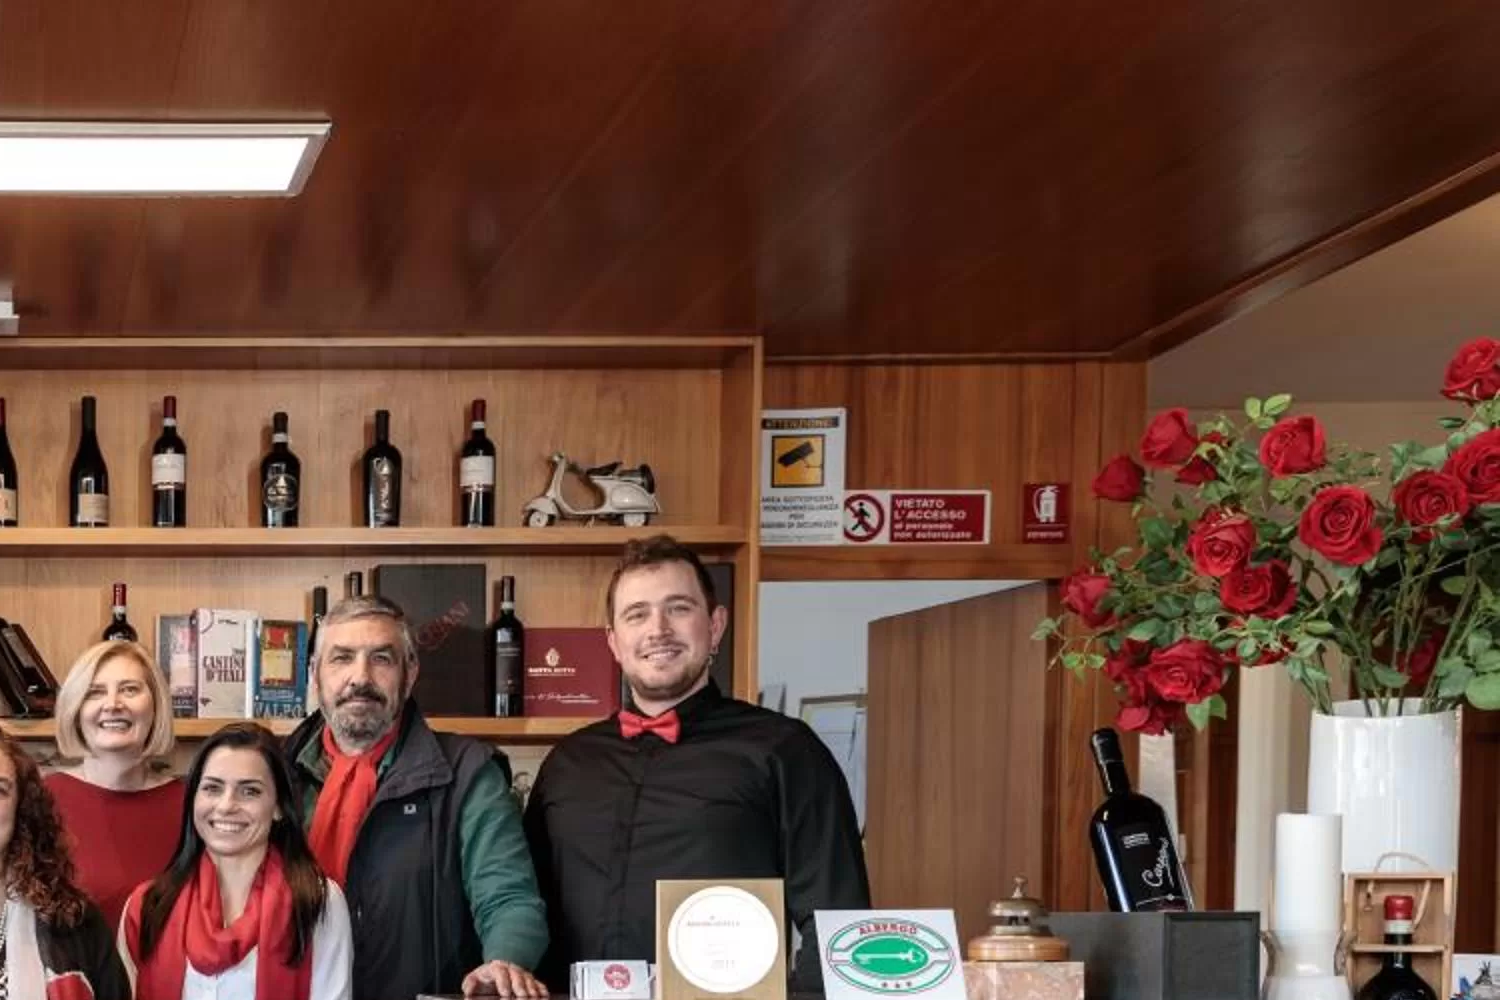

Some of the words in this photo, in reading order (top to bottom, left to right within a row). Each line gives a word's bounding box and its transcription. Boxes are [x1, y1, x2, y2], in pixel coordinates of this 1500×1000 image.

[895, 498, 945, 509] VIETATO
[893, 509, 967, 520] L'ACCESSO
[858, 923, 918, 935] ALBERGO
